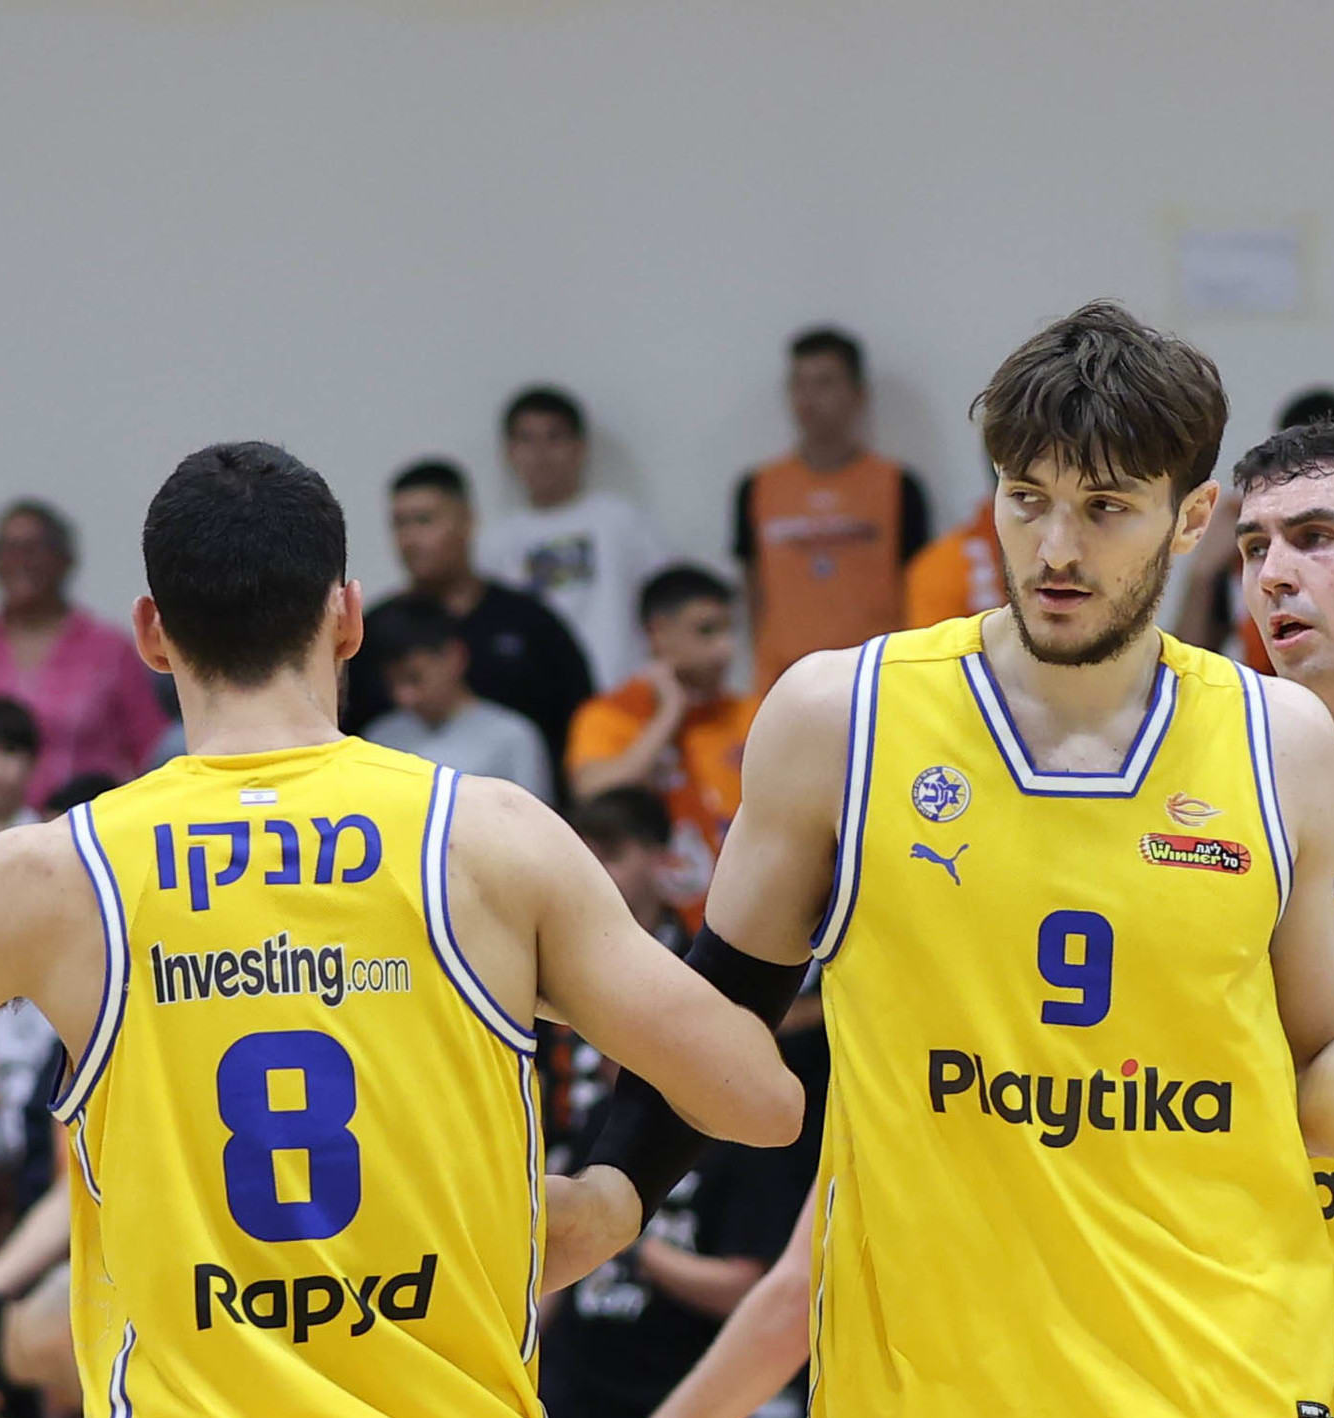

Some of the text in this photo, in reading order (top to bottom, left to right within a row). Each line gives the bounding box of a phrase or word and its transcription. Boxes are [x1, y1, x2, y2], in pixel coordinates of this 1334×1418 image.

[154, 813, 383, 911] מנקו
[1150, 841, 1222, 865] Winner
[1196, 842, 1222, 855] ליגת
[1222, 853, 1239, 868] סל
[151, 930, 412, 1009] Investing.com
[1037, 910, 1115, 1028] 9
[216, 1029, 364, 1244] 8
[927, 1049, 1234, 1149] Playtika
[193, 1253, 439, 1344] Rapyd
